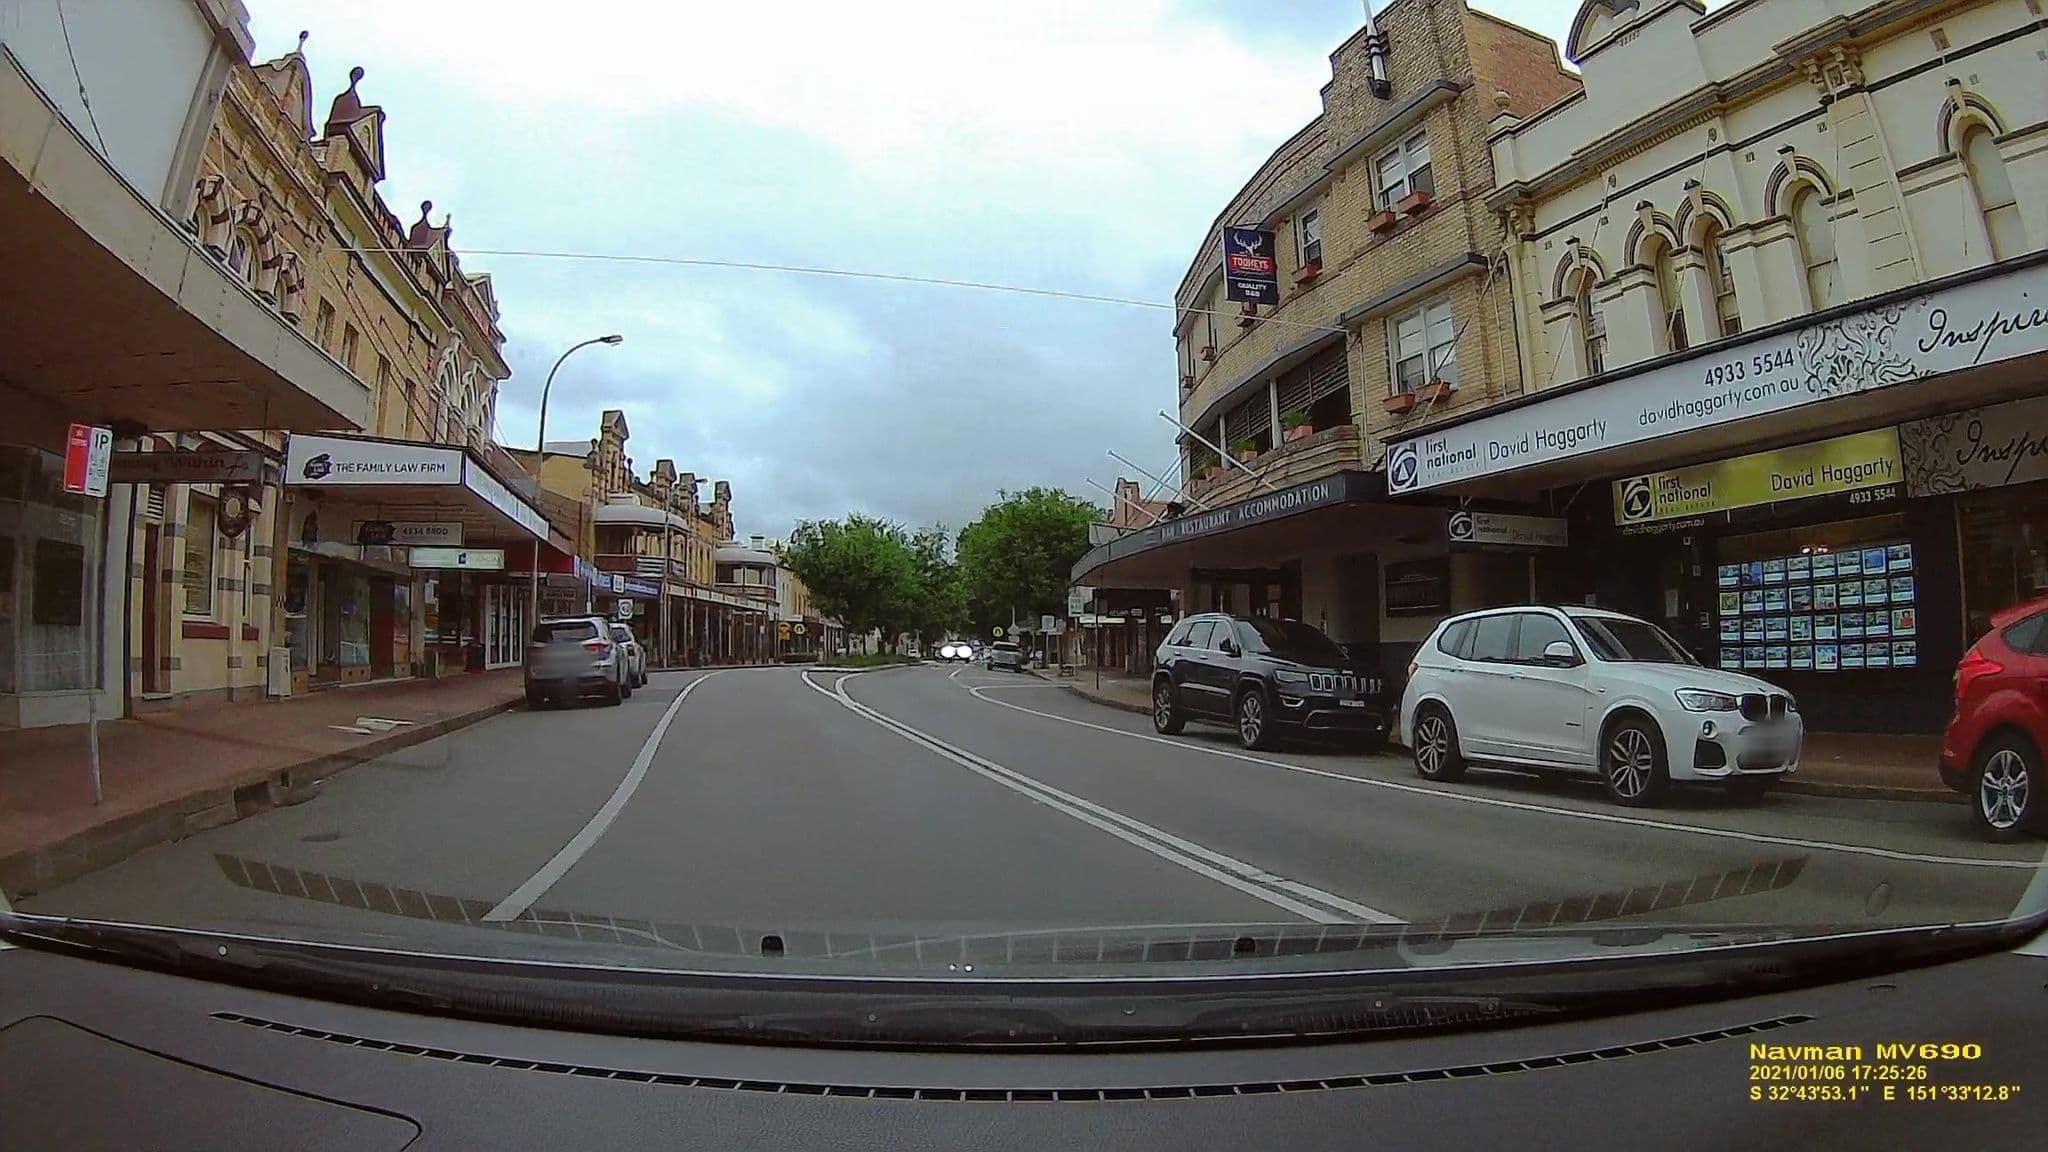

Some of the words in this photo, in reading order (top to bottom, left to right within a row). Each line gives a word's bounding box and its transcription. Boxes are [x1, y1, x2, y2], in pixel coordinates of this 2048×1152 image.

[1232, 257, 1268, 270] TOOHEYS
[1918, 291, 2048, 364] Inspir
[1704, 363, 1745, 388] 4933
[1753, 347, 1795, 375] 5544
[1639, 374, 1799, 426] davidhaggarty.com.au
[1425, 437, 1448, 455] first
[1489, 432, 1528, 461] David
[1535, 419, 1607, 450] Haggarty
[336, 463, 355, 473] THE
[356, 463, 392, 473] FAMILY
[394, 464, 417, 473] LAW
[421, 464, 446, 473] FIRM
[1426, 446, 1477, 470] national
[1658, 474, 1682, 491] first
[1771, 468, 1814, 492] David
[1821, 457, 1894, 489] Haggarty
[1659, 480, 1711, 504] national
[1849, 489, 1872, 505] 4933
[1874, 486, 1896, 502] 5544
[1181, 510, 1230, 535] RESTAURANT
[1238, 483, 1329, 521] ACCOMMODATION
